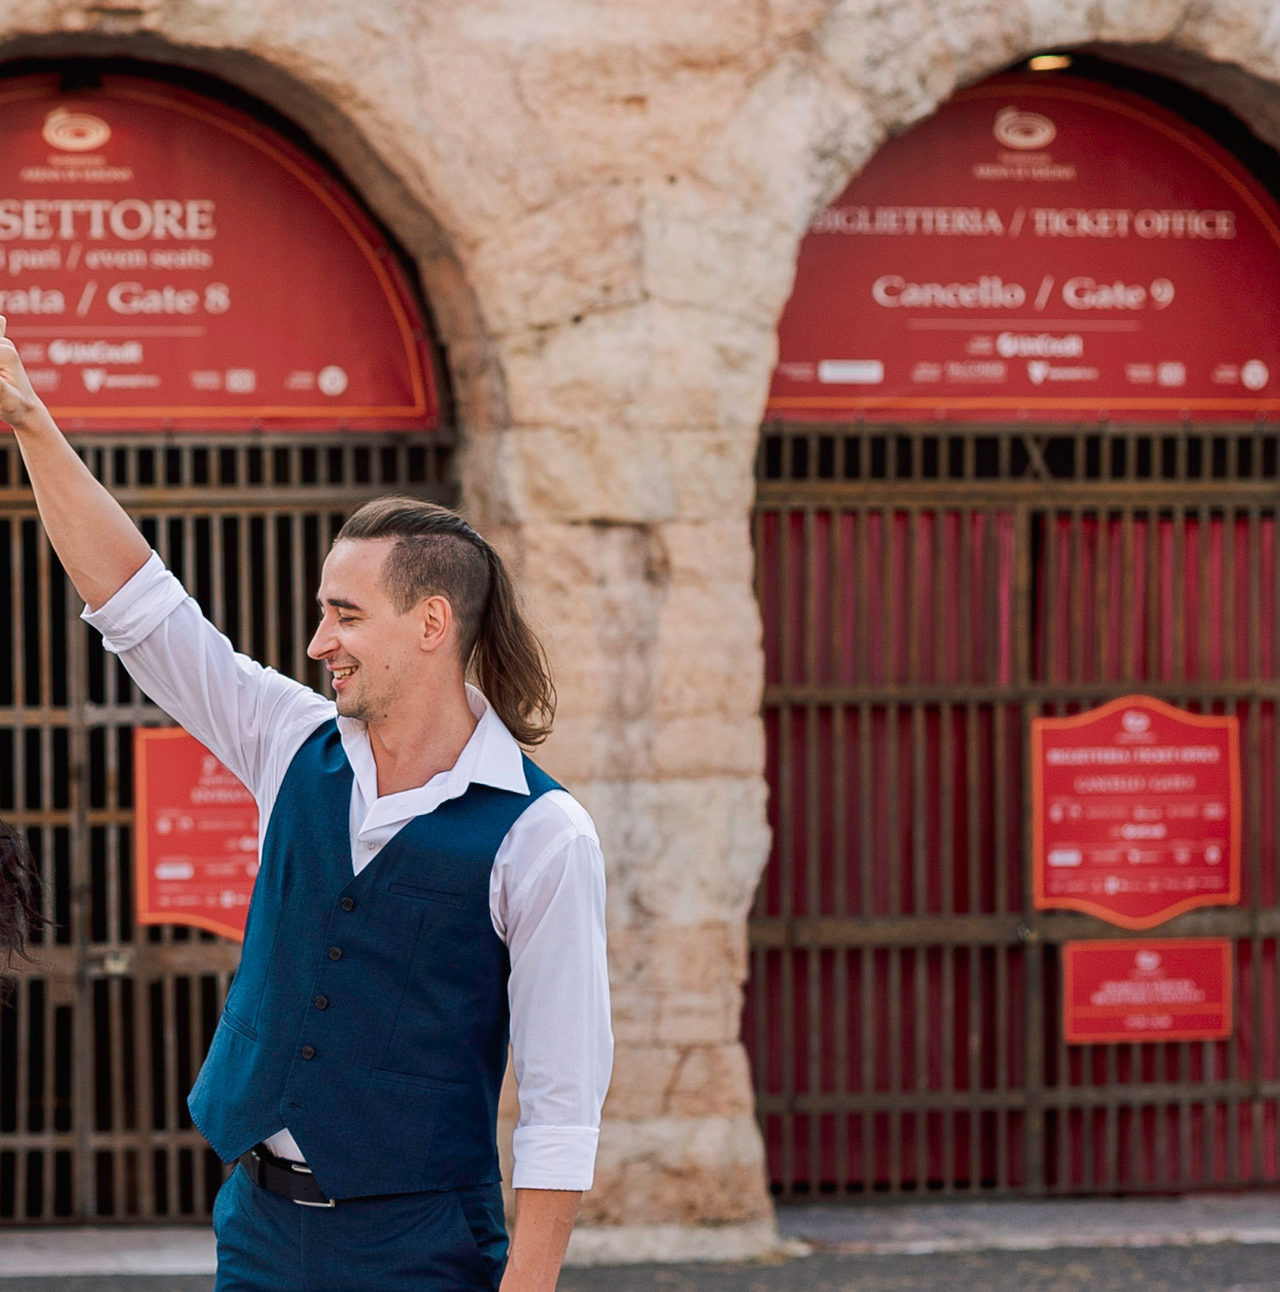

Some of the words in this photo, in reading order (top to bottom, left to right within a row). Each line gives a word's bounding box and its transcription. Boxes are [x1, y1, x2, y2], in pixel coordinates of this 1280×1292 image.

[1031, 208, 1131, 237] TICKET
[1135, 209, 1235, 238] OFFICE
[9, 245, 61, 275] pari
[85, 250, 147, 269] even
[150, 247, 212, 269] seats
[76, 280, 98, 317] /
[108, 282, 198, 314] Gate
[205, 282, 229, 314] 8
[873, 275, 1025, 308] Cancello
[1034, 274, 1055, 311] /
[1062, 276, 1146, 309] Gate
[1151, 277, 1175, 309] 9
